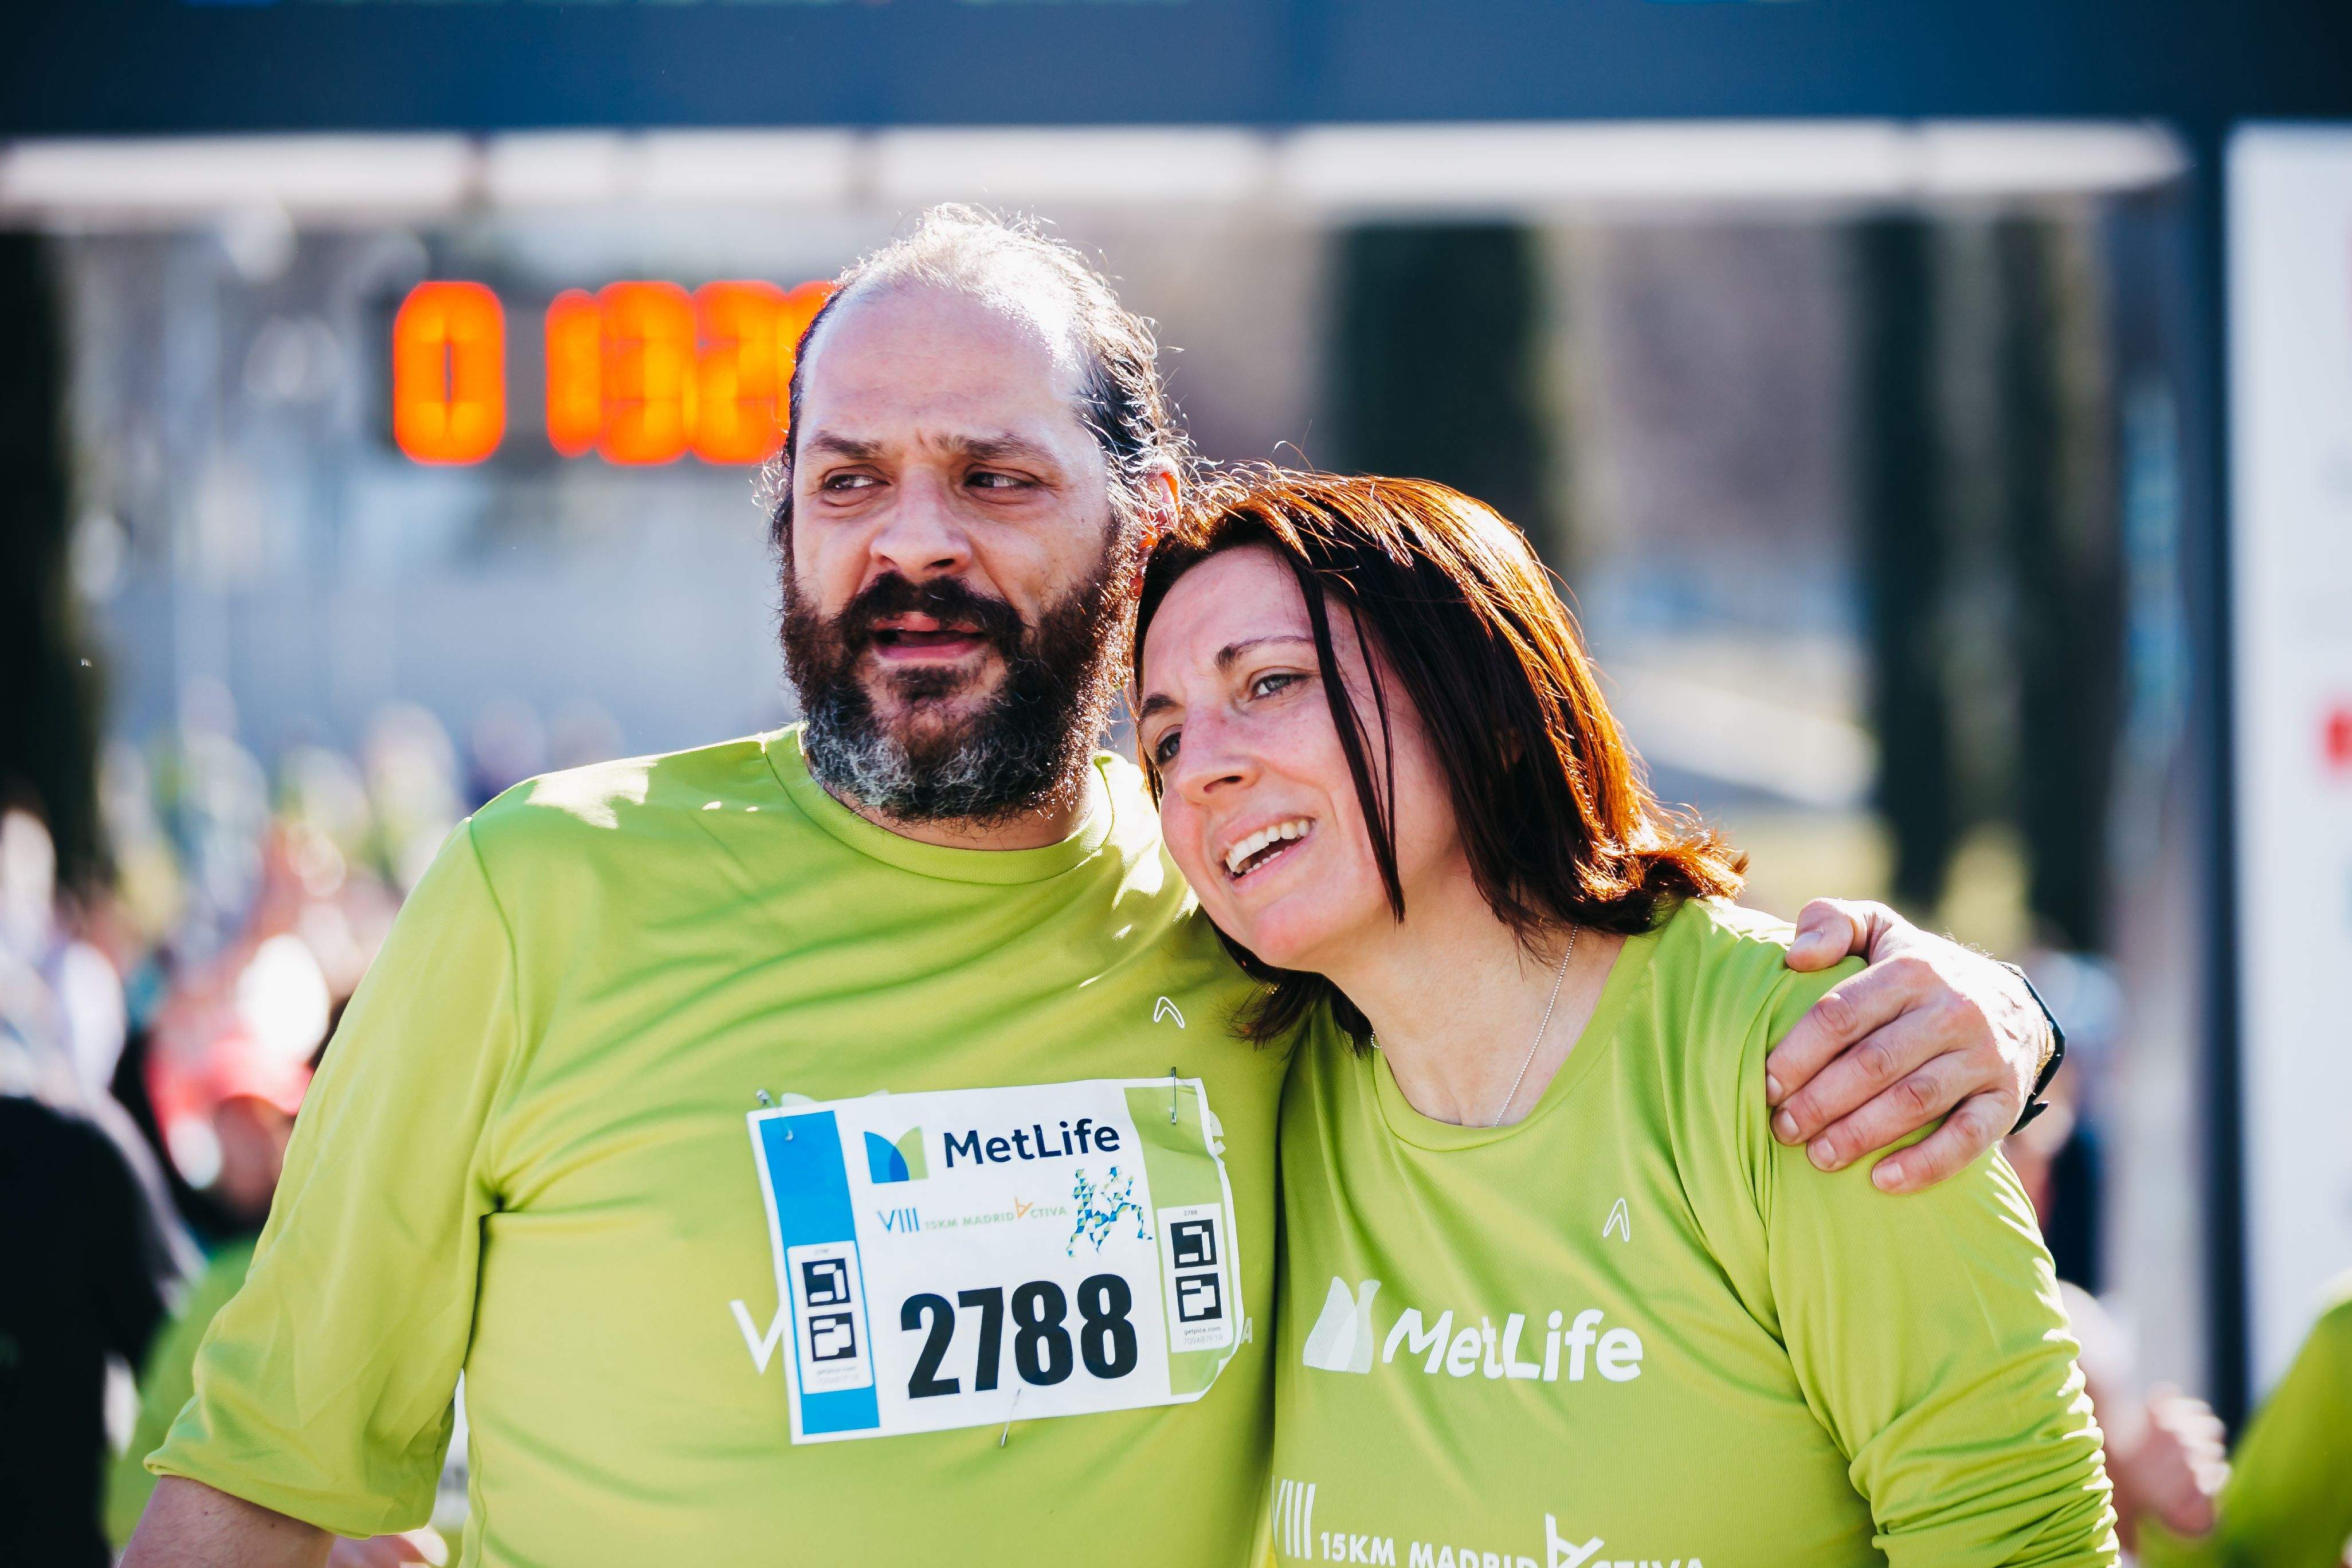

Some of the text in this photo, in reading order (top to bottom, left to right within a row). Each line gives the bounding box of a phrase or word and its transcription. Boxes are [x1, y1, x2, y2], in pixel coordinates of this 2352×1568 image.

[943, 1119, 1120, 1168] MetLife
[877, 1206, 920, 1233] VIII
[924, 1218, 958, 1231] 15KM
[963, 1212, 1014, 1228] MADRID
[900, 1273, 1138, 1400] 2788
[1382, 1308, 1643, 1382] MetLife
[1320, 1531, 1397, 1567] 15KM
